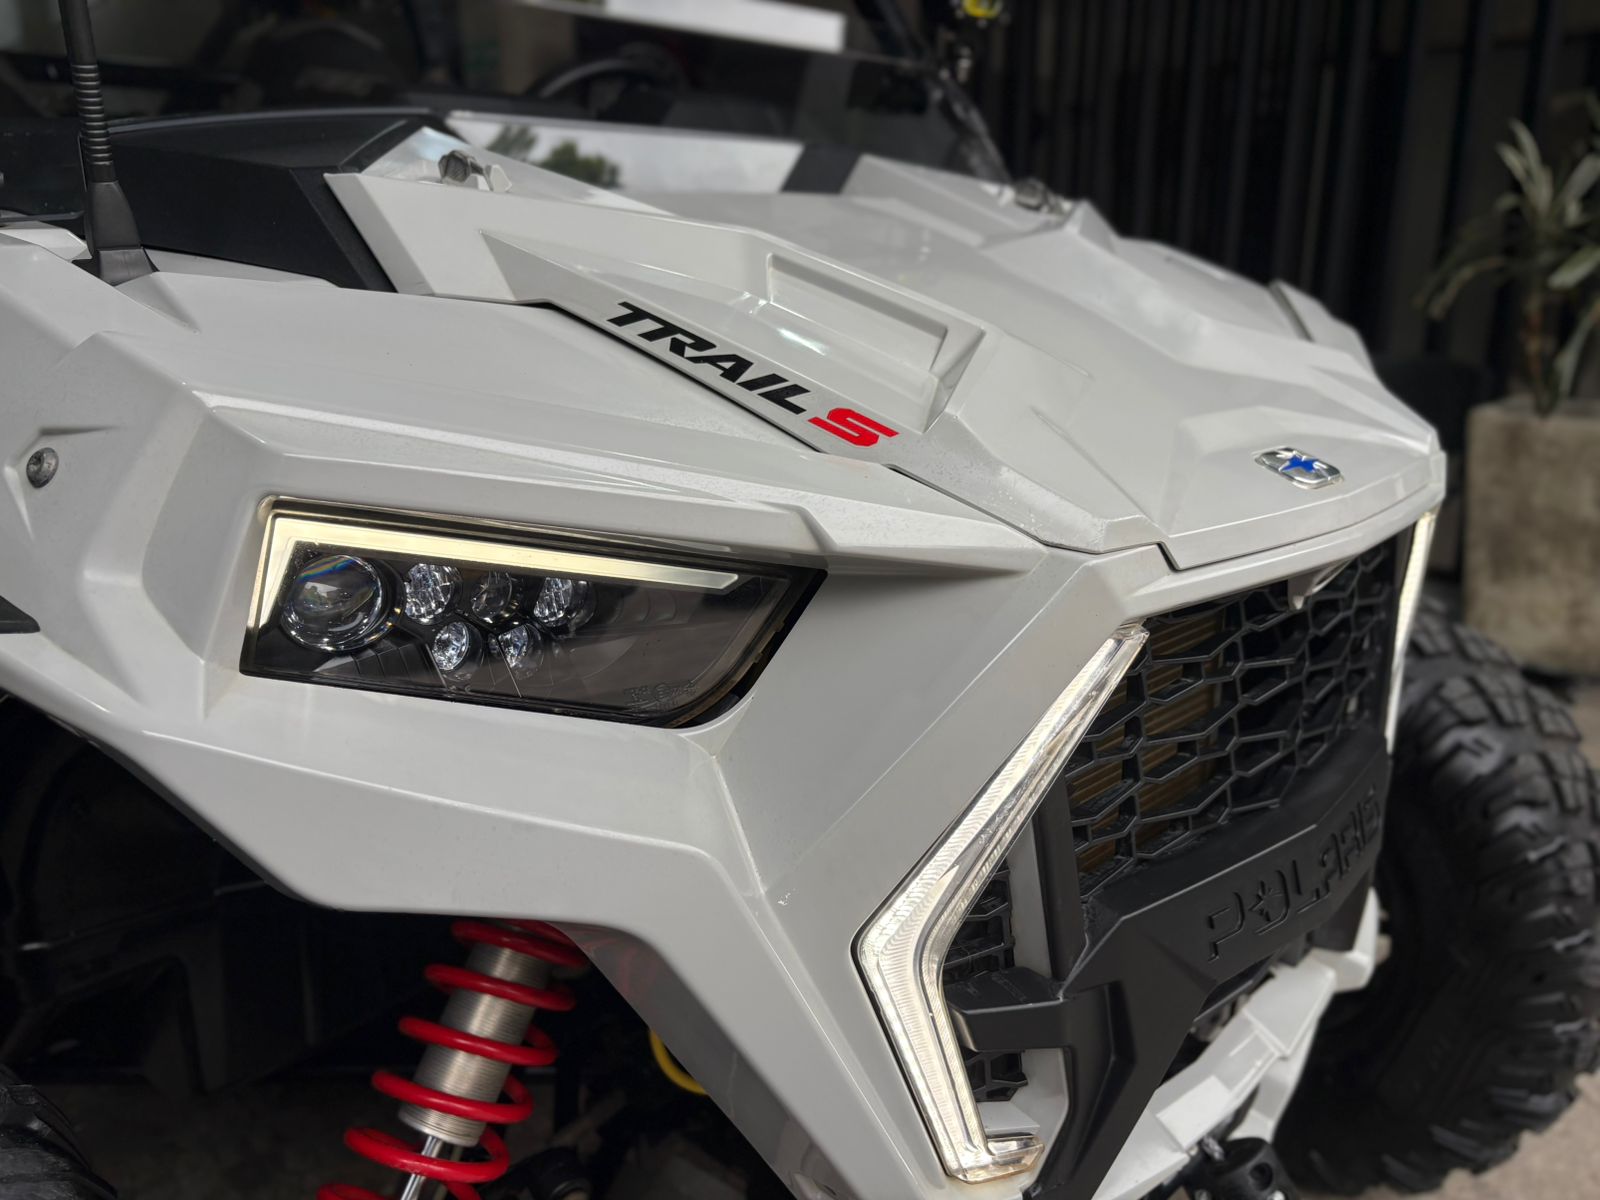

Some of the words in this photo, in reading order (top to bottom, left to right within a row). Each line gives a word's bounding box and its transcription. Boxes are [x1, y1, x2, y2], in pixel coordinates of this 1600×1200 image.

[606, 301, 811, 415] TRAIL
[808, 407, 900, 447] S
[1206, 785, 1382, 963] POLARIS
